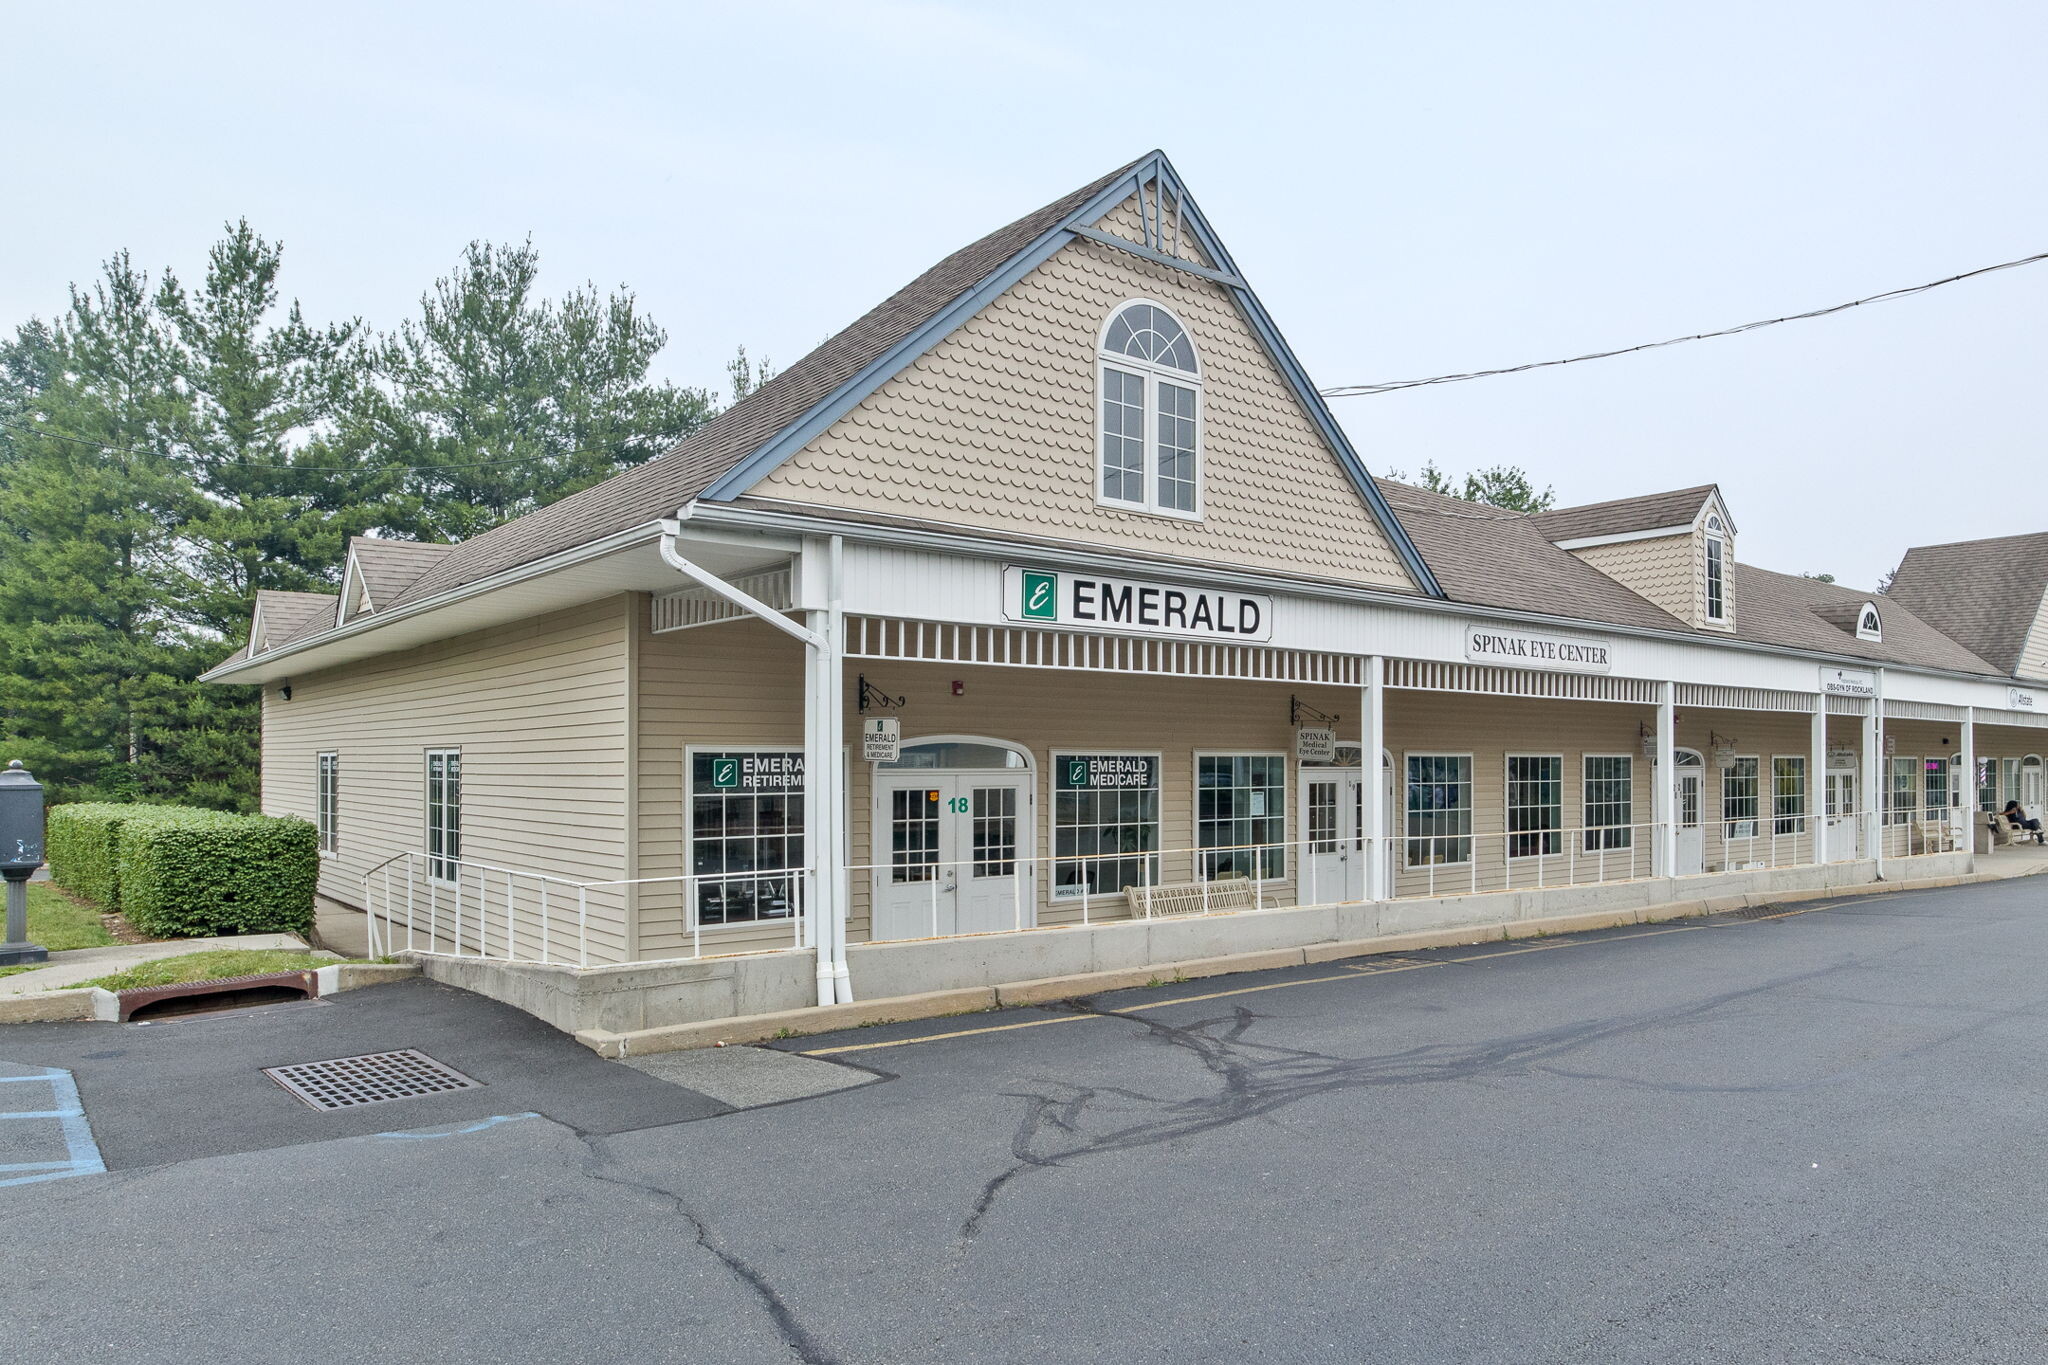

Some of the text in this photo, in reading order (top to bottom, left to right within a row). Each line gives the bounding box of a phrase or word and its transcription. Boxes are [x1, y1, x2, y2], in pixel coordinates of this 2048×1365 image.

[1073, 579, 1260, 635] EMERALD
[1472, 633, 1608, 665] SPINAK EYE CENTER
[1852, 685, 1874, 694] ROCKLAND
[865, 733, 896, 743] EMERALD
[1299, 732, 1330, 741] SPINAK
[866, 743, 894, 751] RETIREMENT
[1302, 740, 1327, 748] Medical
[870, 751, 893, 759] MEDICARE
[1299, 748, 1310, 757] Eye
[1089, 760, 1148, 773] EMERALD
[1089, 774, 1148, 786] MEDICARE
[947, 797, 969, 814] 18
